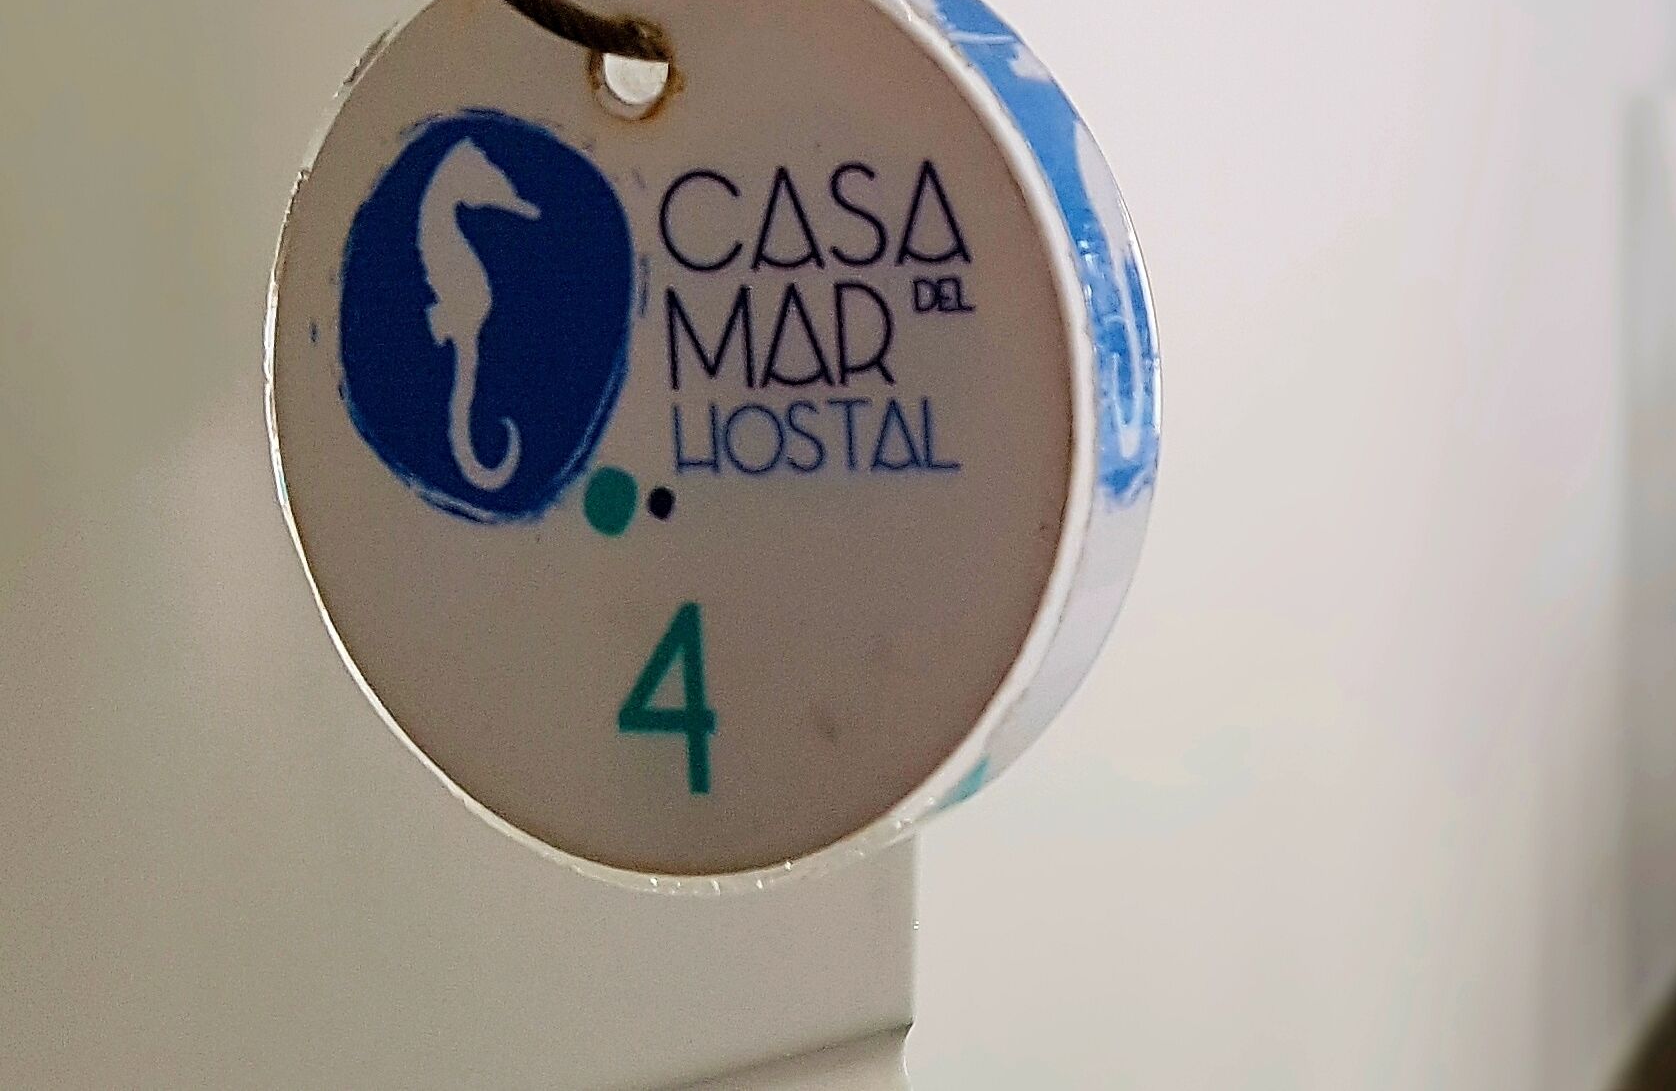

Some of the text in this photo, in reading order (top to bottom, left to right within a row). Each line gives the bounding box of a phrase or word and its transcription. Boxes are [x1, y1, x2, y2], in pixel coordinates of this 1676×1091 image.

[659, 160, 973, 271] CASA
[663, 283, 895, 390] MAR
[912, 276, 976, 312] DEL
[672, 397, 962, 475] HOSTAL
[618, 601, 716, 795] 4
